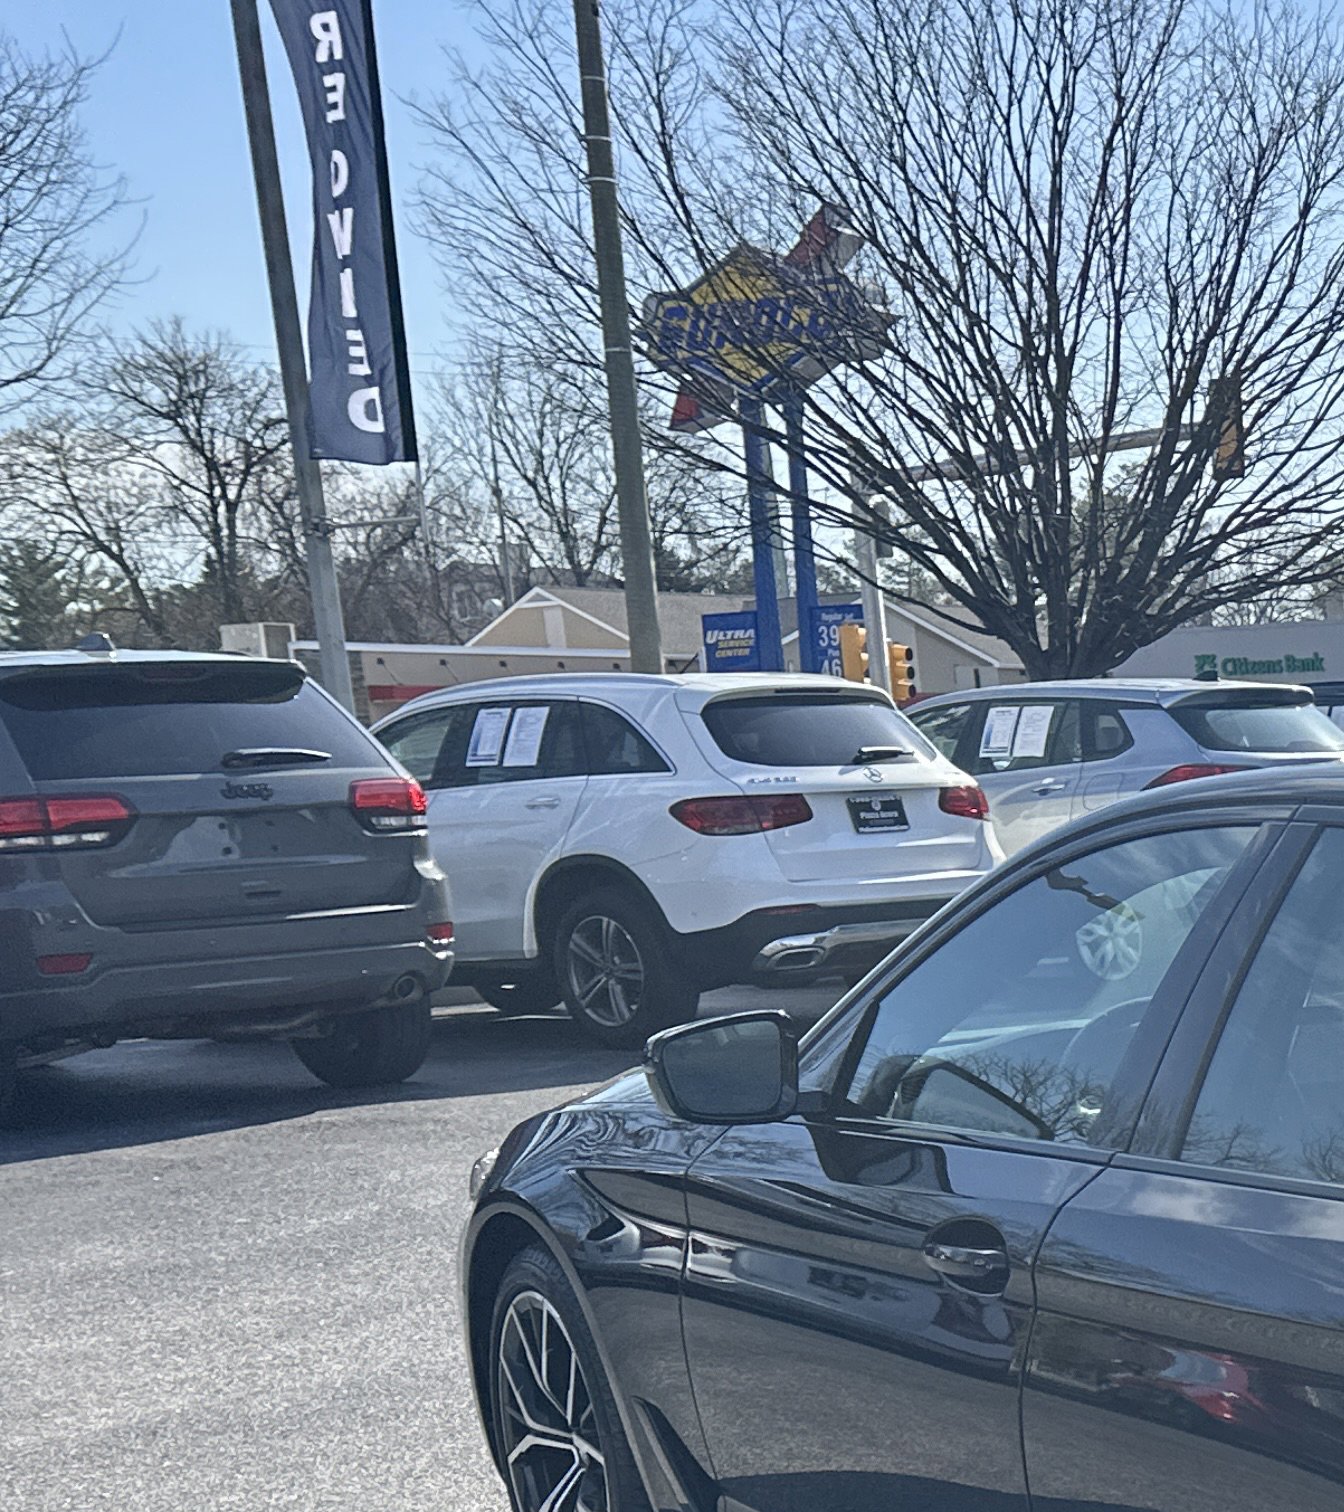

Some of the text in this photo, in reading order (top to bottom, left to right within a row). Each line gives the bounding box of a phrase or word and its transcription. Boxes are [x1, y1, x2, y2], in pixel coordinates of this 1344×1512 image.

[705, 628, 756, 645] ULTRA
[818, 625, 840, 647] 39
[1221, 651, 1325, 676] Citizens Bank
[220, 781, 273, 801] Jeep
